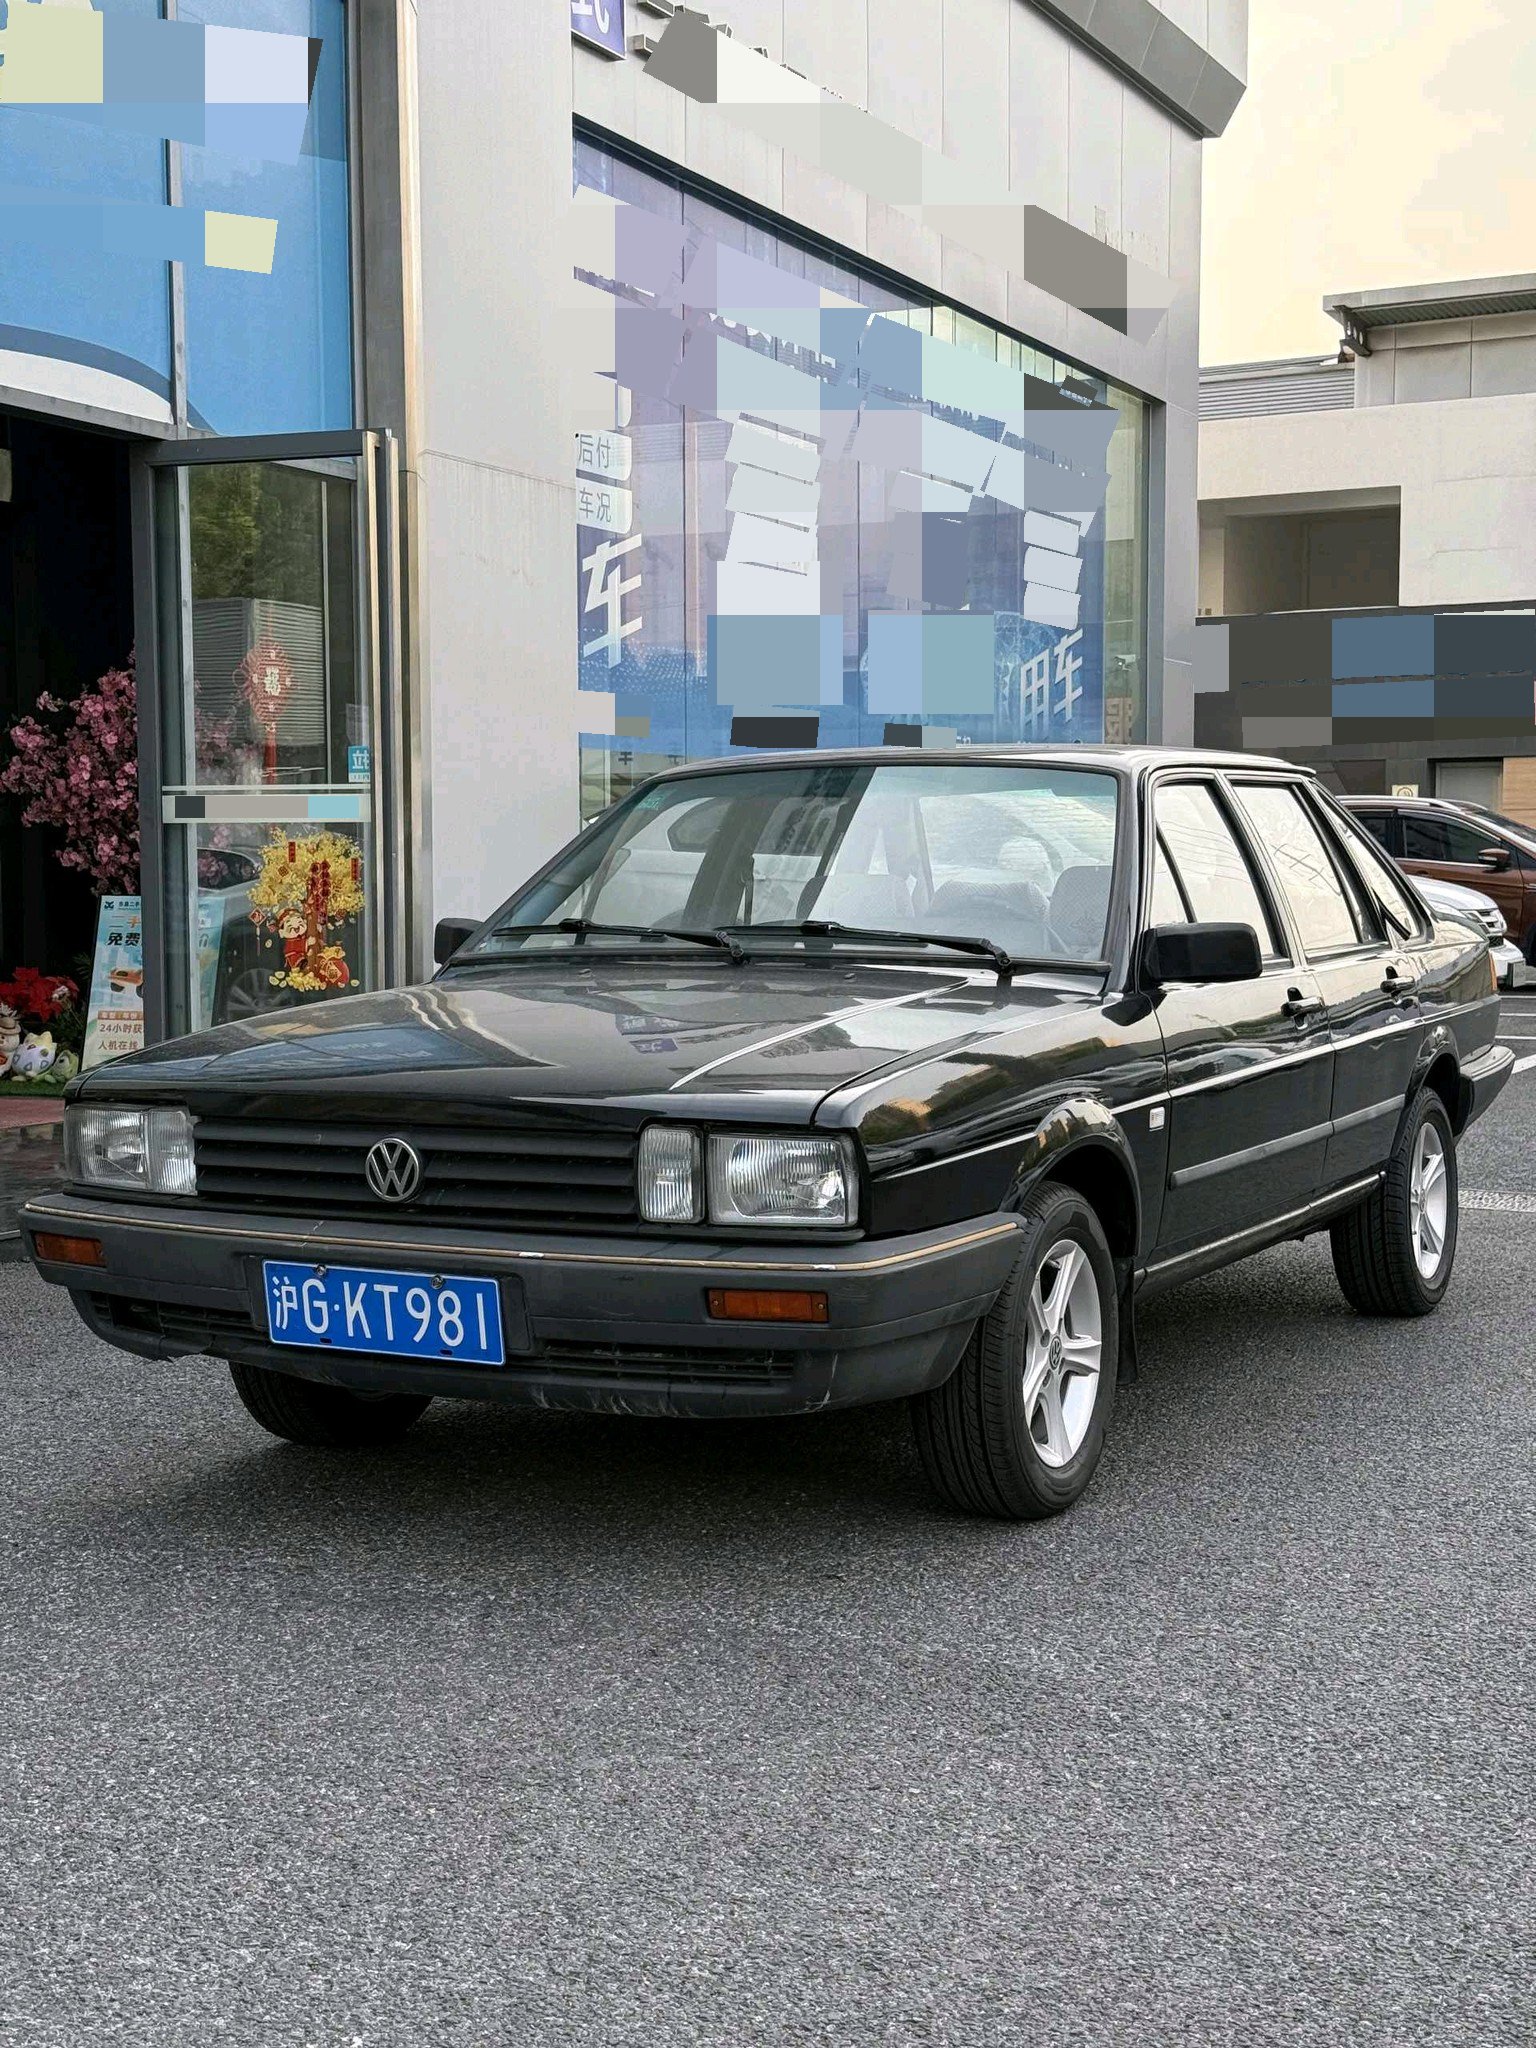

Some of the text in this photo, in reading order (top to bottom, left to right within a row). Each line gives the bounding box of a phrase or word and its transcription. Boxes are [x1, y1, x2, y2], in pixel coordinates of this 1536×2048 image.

[577, 433, 612, 470] 后付
[579, 487, 612, 523] 车况
[581, 533, 643, 670] 车
[1020, 628, 1084, 743] 用车
[107, 932, 140, 946] 免费
[272, 1276, 488, 1351] 沪G·KT981
